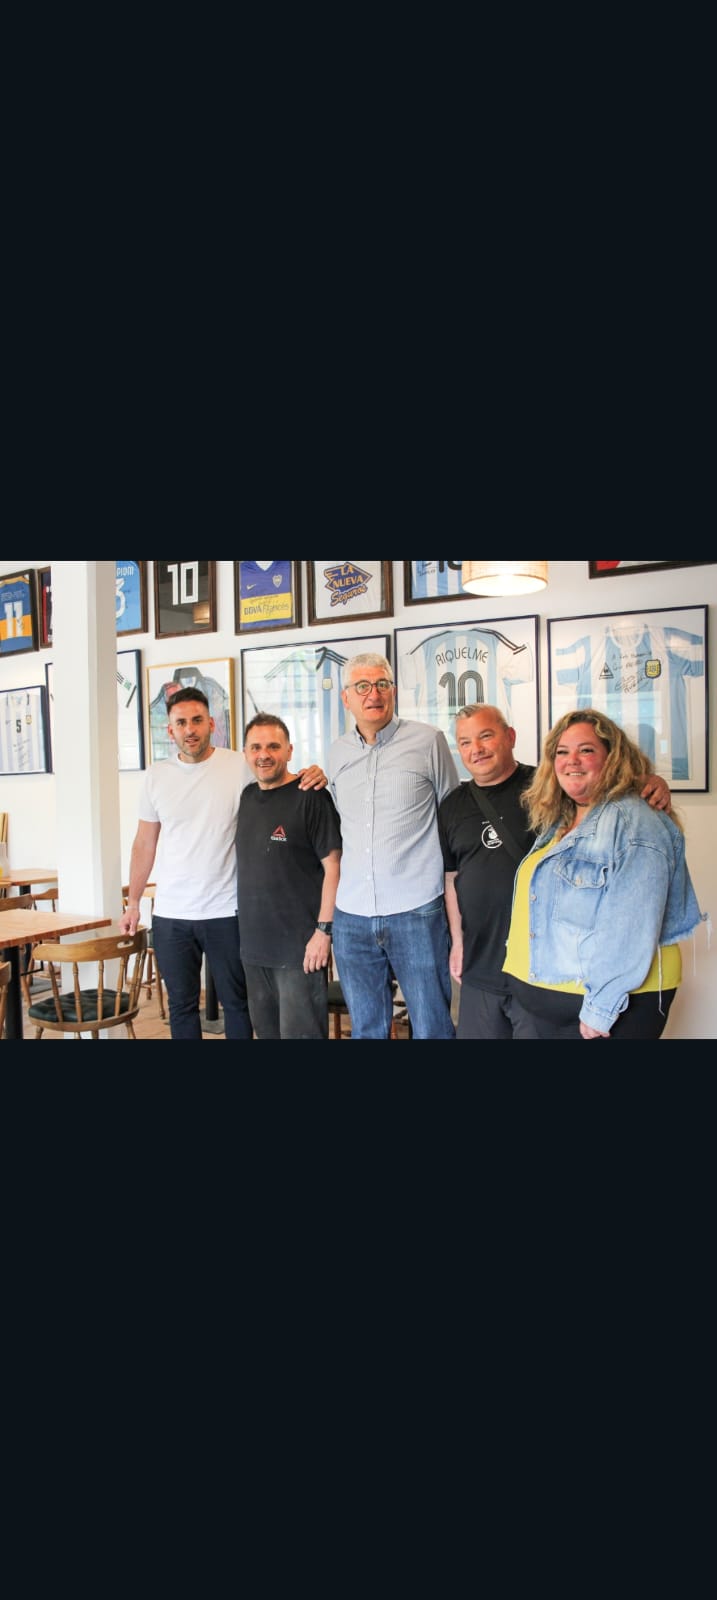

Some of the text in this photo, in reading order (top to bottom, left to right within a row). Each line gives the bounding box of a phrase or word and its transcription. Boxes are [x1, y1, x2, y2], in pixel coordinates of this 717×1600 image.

[341, 565, 353, 575] LA
[168, 561, 199, 606] 10
[333, 575, 363, 588] NUEVA
[4, 601, 23, 638] 11
[436, 647, 488, 666] RIQUELME
[439, 670, 484, 708] 10
[16, 719, 22, 733] 5
